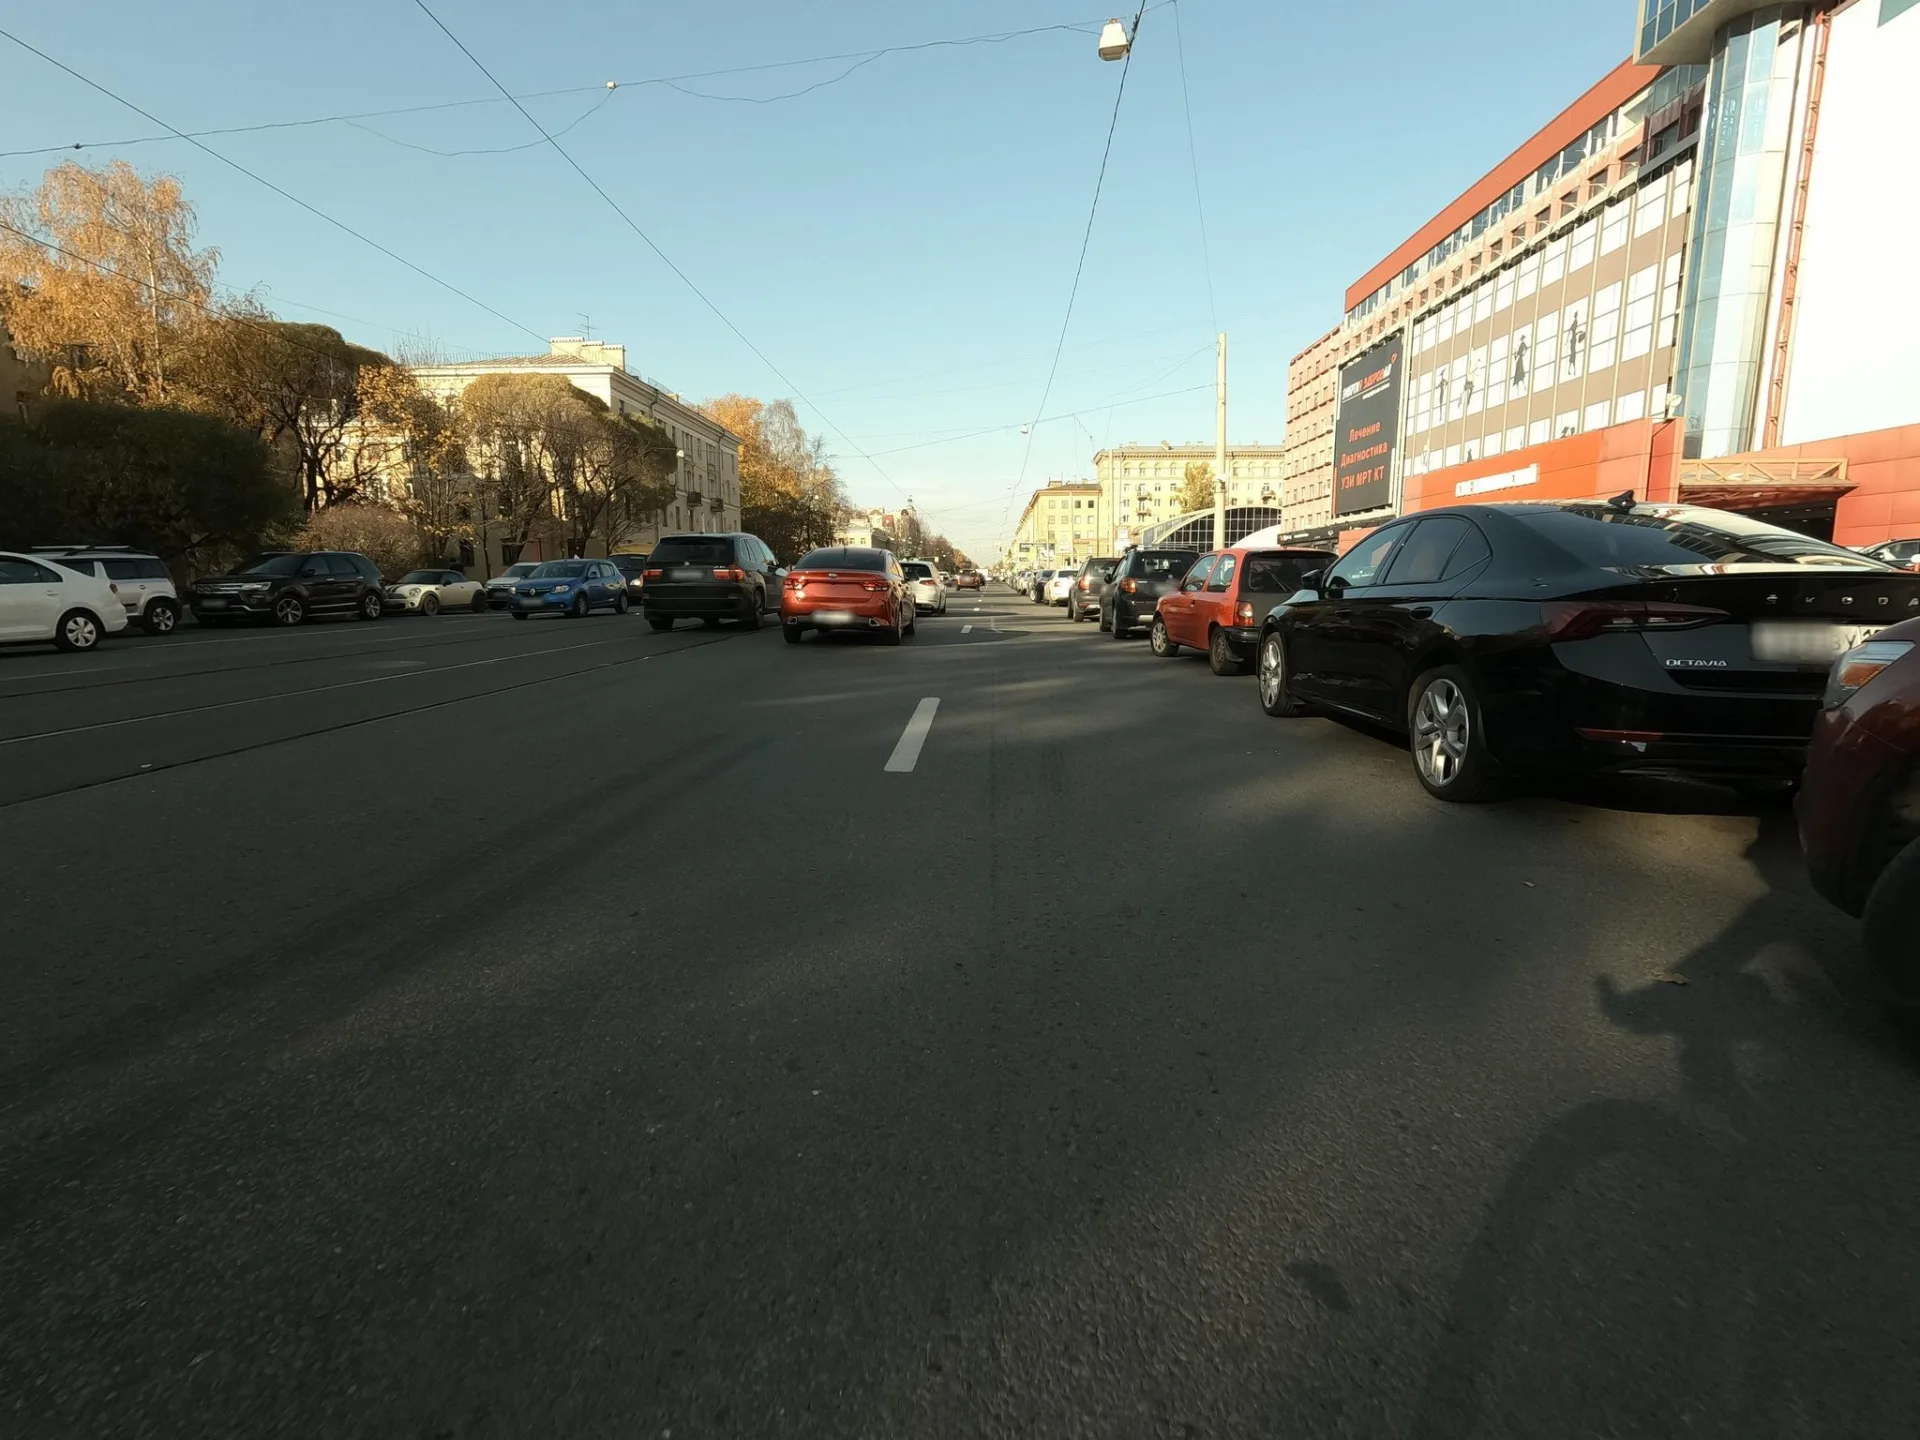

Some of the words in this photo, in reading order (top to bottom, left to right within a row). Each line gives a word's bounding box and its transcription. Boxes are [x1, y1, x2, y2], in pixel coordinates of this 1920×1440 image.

[1349, 421, 1380, 443] Лечение
[1341, 442, 1388, 469] Диагностика
[1341, 474, 1355, 490] УЗИ
[1356, 469, 1372, 486] МРТ
[1374, 465, 1385, 481] КТ
[1665, 659, 1727, 667] OCTAVIA
